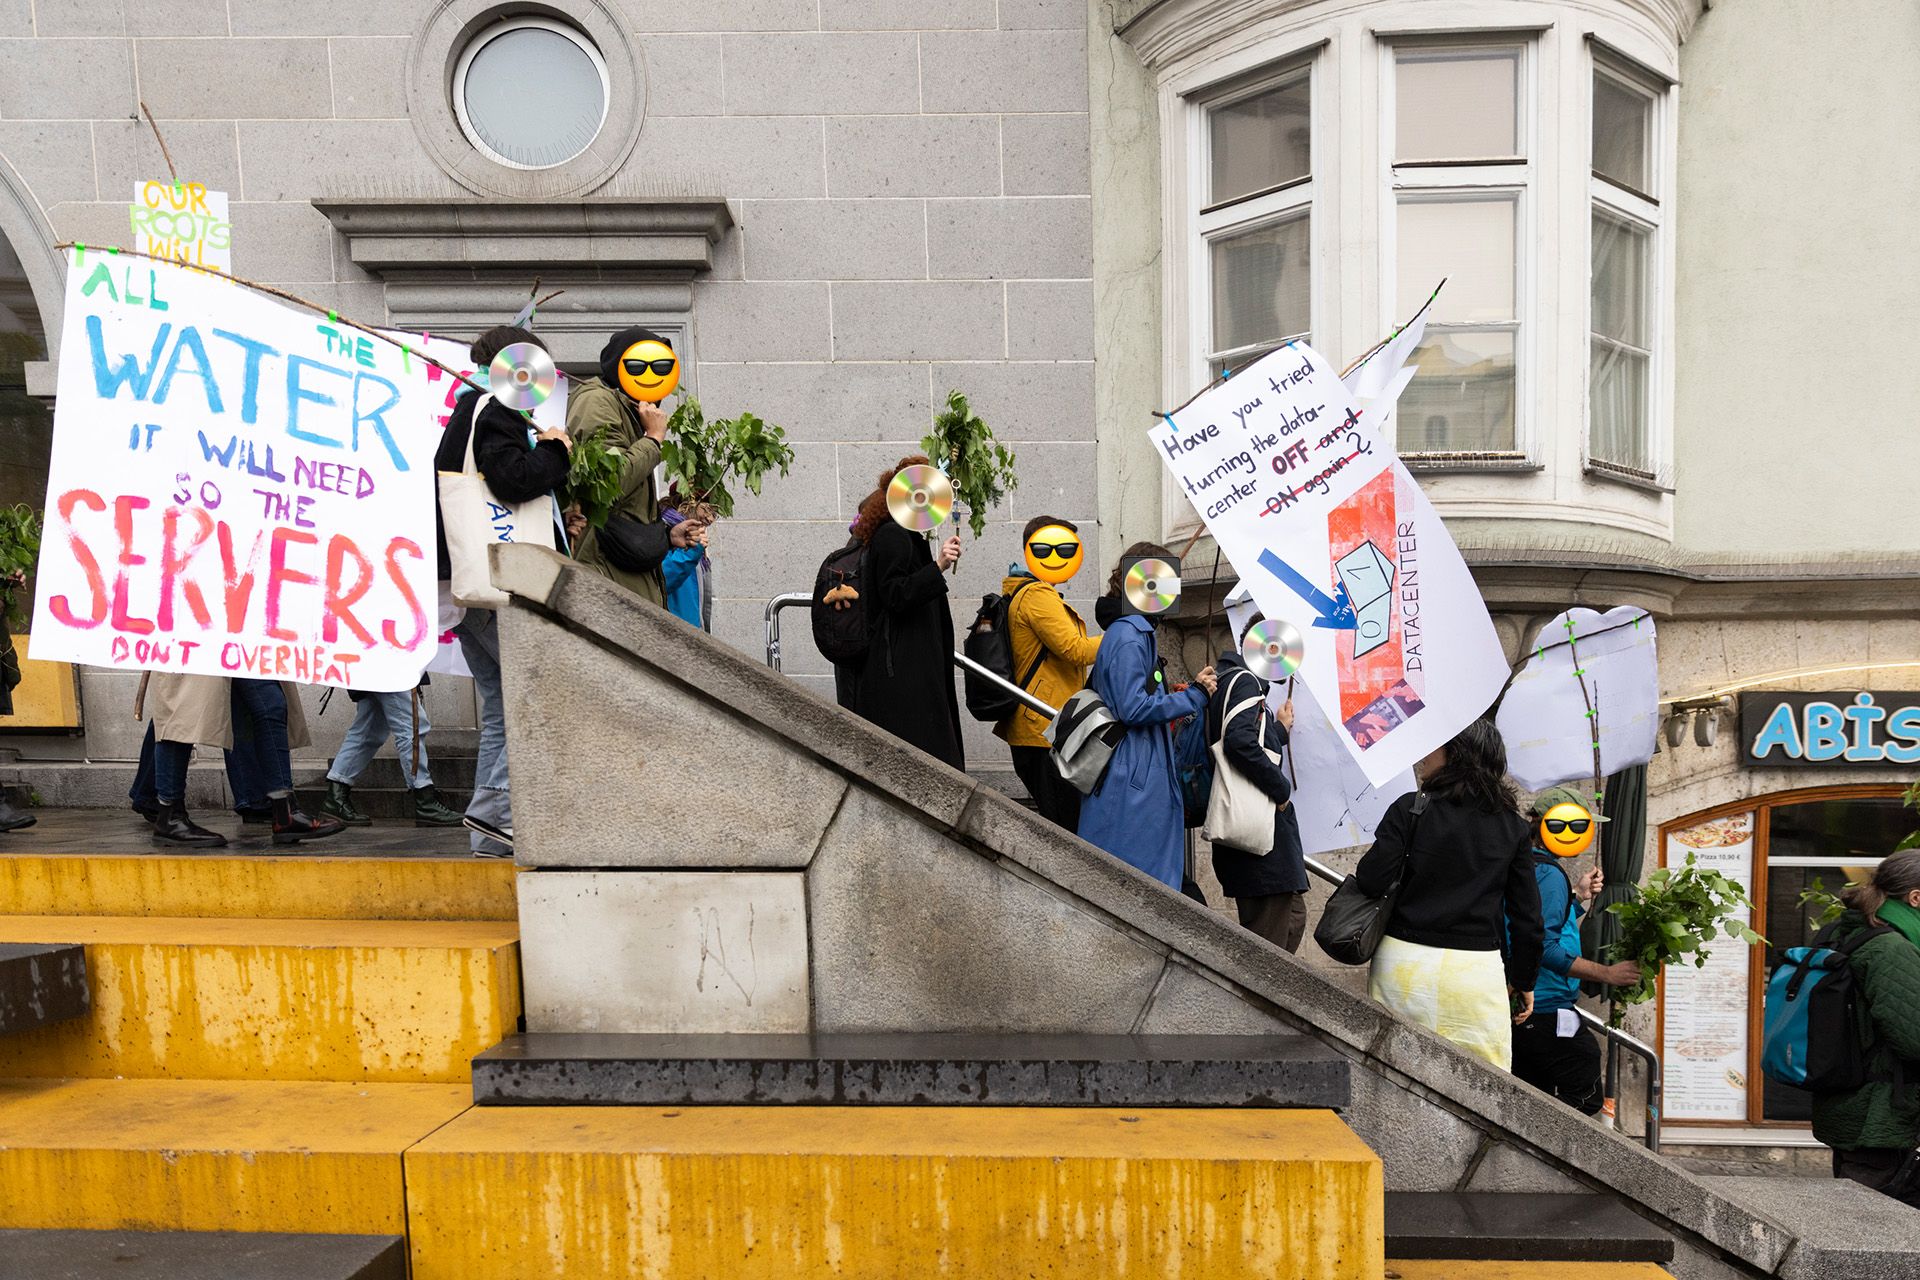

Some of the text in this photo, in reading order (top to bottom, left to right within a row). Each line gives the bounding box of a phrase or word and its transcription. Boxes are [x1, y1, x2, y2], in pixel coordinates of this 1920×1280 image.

[129, 203, 234, 249] ROOTS
[144, 180, 211, 216] OUR
[81, 263, 377, 368] ALL THE
[86, 315, 410, 472] WATER
[1162, 355, 1315, 461] Have you tried
[129, 424, 375, 499] IT WILL NEED
[1183, 403, 1326, 496] turning the data-
[1206, 406, 1360, 519] center OFF and
[173, 471, 316, 528] SO THE
[1264, 484, 1300, 515] ON
[49, 488, 428, 652] SERVERS
[1397, 521, 1423, 672] DATACENTER
[111, 635, 361, 686] DON'T OVERHEAT
